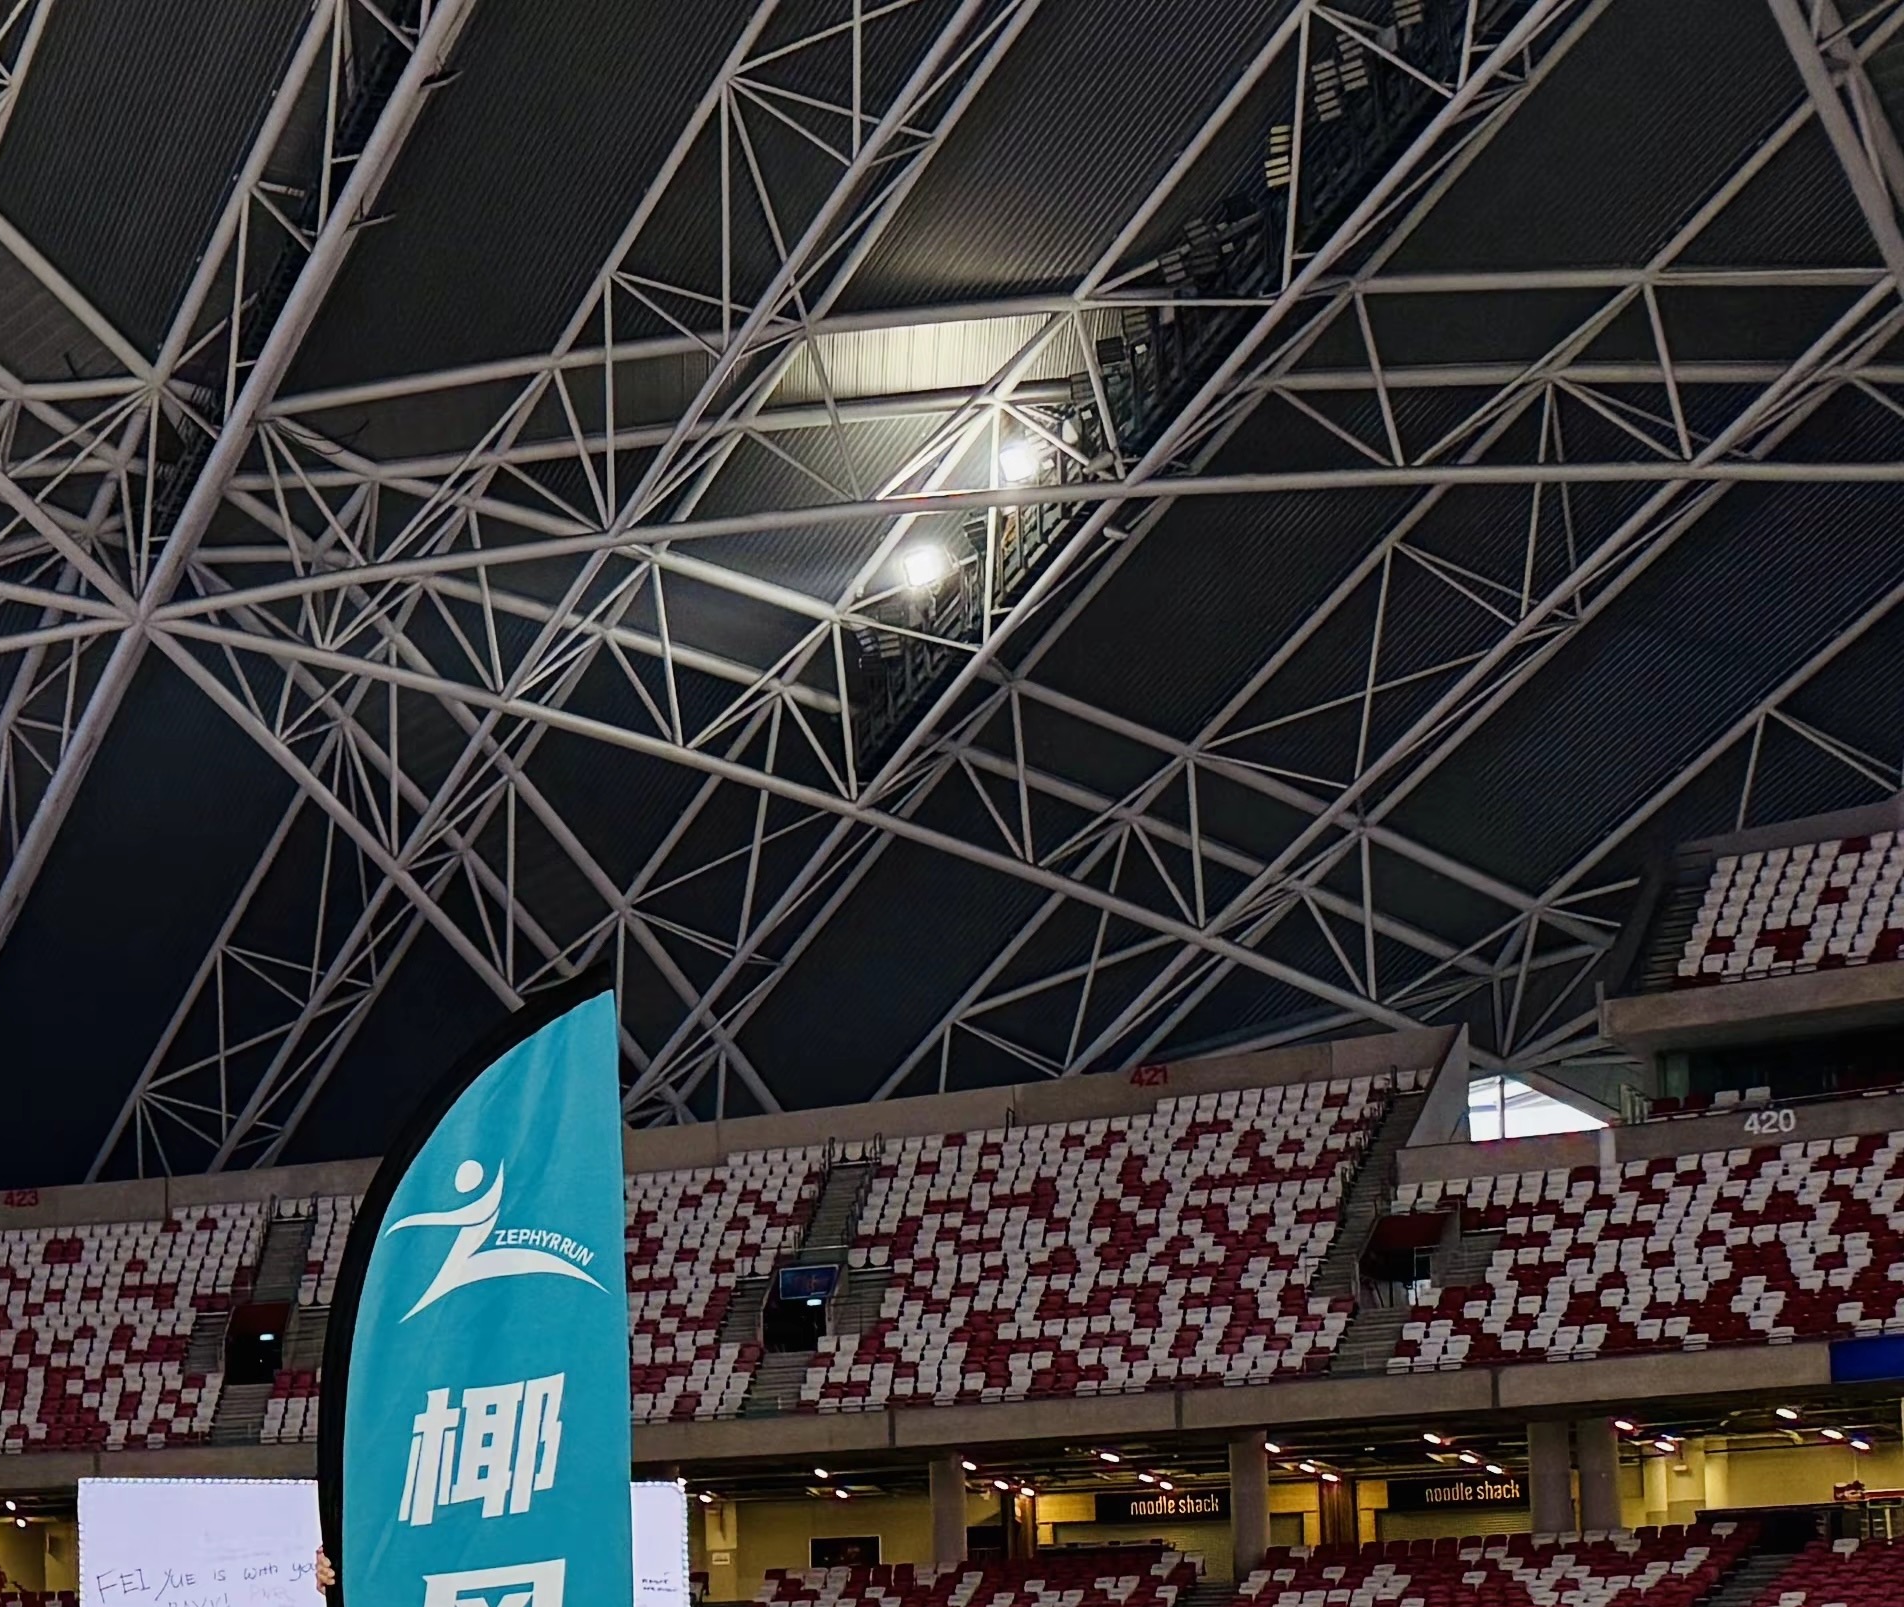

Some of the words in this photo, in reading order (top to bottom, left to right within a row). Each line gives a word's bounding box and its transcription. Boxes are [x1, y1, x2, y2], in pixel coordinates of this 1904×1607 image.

[1129, 1065, 1169, 1088] 421
[1743, 1108, 1797, 1136] 420
[3, 1189, 39, 1209] 423
[1425, 1481, 1472, 1503] noodle
[1477, 1478, 1520, 1500] shack
[1130, 1494, 1175, 1516] noodle
[1179, 1493, 1220, 1514] shack
[288, 1563, 316, 1582] yo
